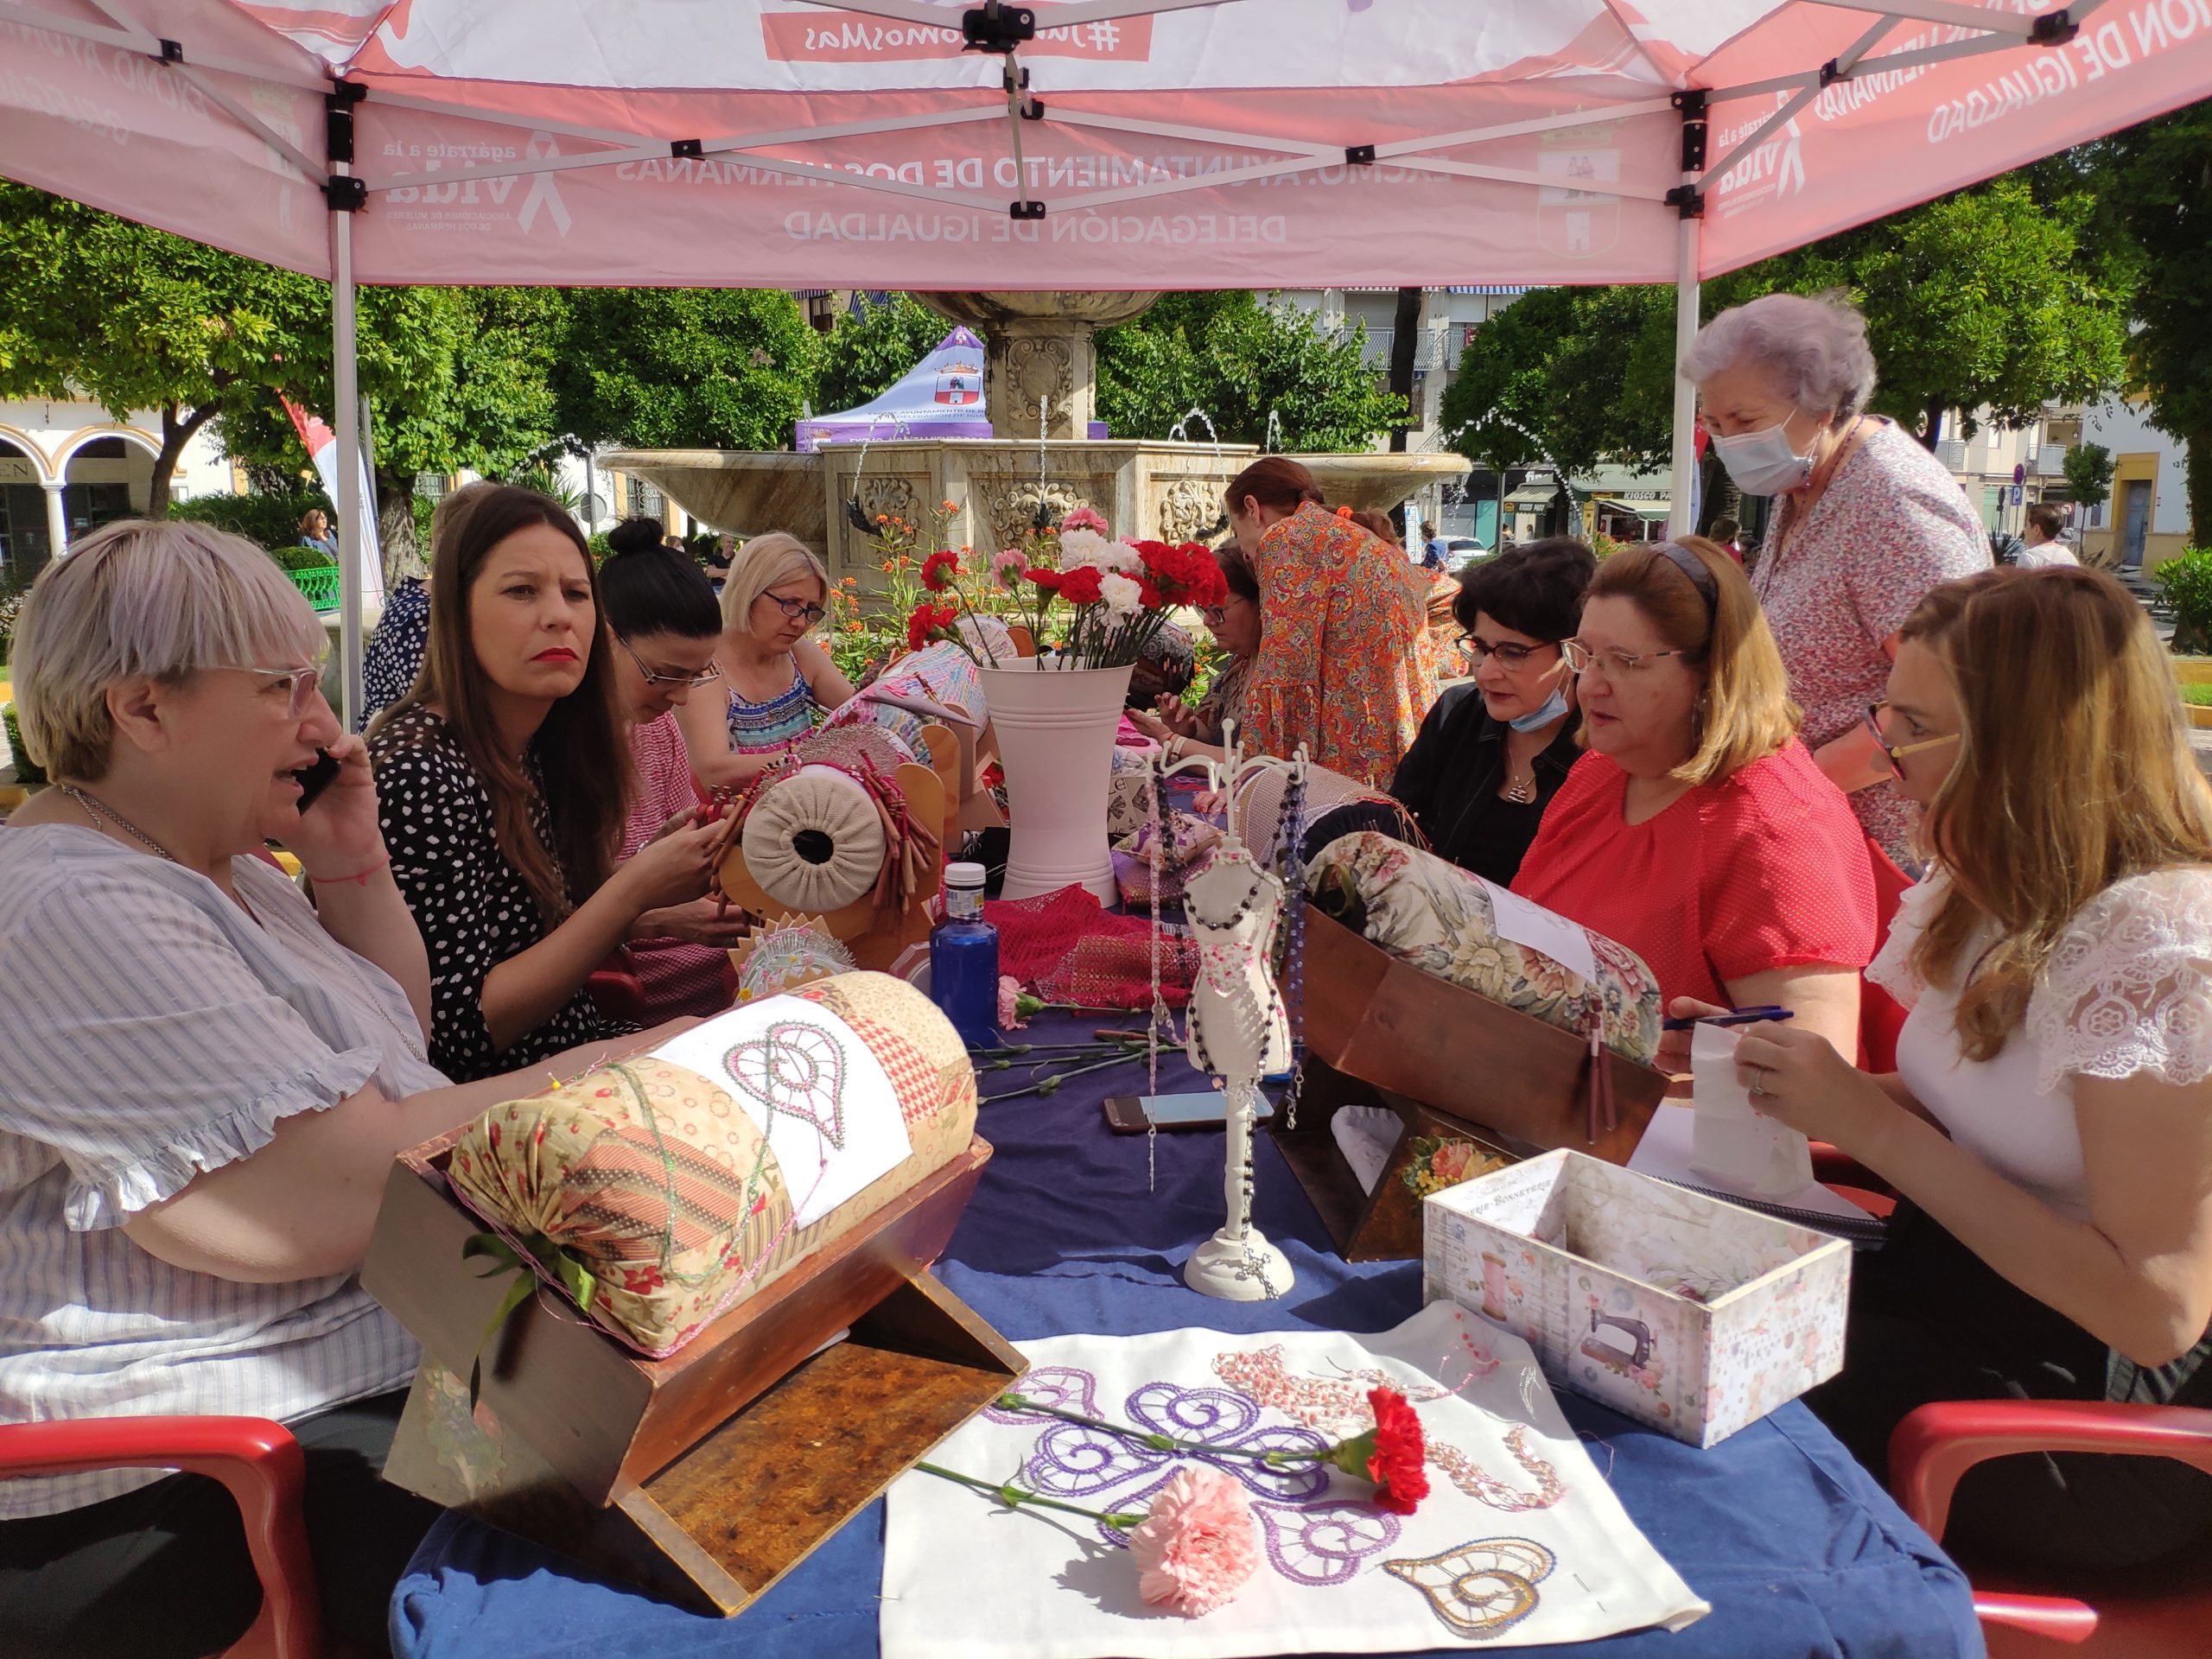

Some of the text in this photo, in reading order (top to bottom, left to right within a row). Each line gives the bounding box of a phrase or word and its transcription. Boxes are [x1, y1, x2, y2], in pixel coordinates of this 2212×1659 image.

[1624, 491, 1673, 500] KIOSCO PA
[2012, 486, 2022, 505] P
